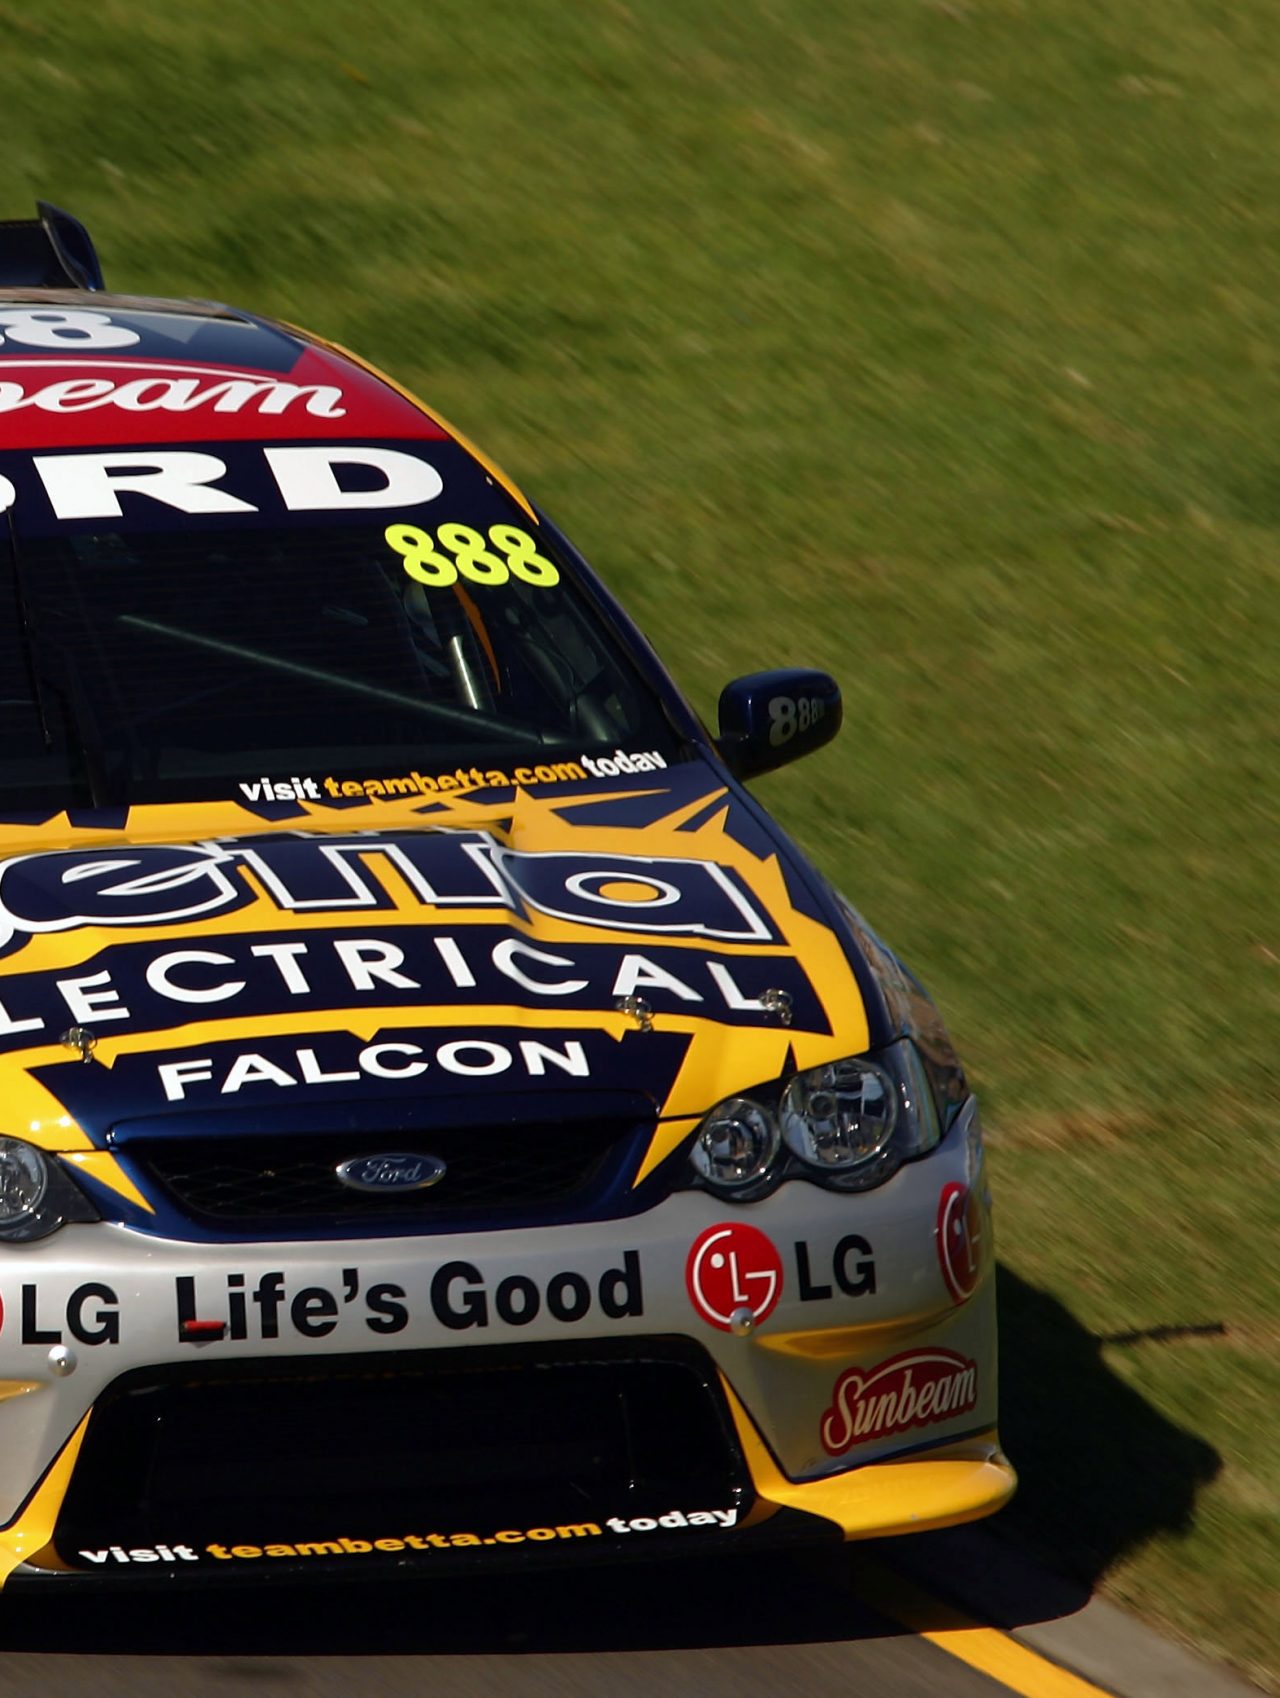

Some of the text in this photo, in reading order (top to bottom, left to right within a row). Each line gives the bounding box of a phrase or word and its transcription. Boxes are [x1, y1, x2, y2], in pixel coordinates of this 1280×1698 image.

[384, 522, 560, 588] 888
[240, 749, 668, 803] visit teambetta.com today
[157, 1039, 591, 1102] FALCON
[361, 1157, 422, 1185] Ford
[21, 1282, 120, 1345] LG
[176, 1268, 410, 1343] Life's
[430, 1249, 644, 1330] Good
[795, 1233, 877, 1302] LG
[823, 1354, 976, 1449] Sunbeam
[79, 1504, 740, 1565] visit teambetta.com today
